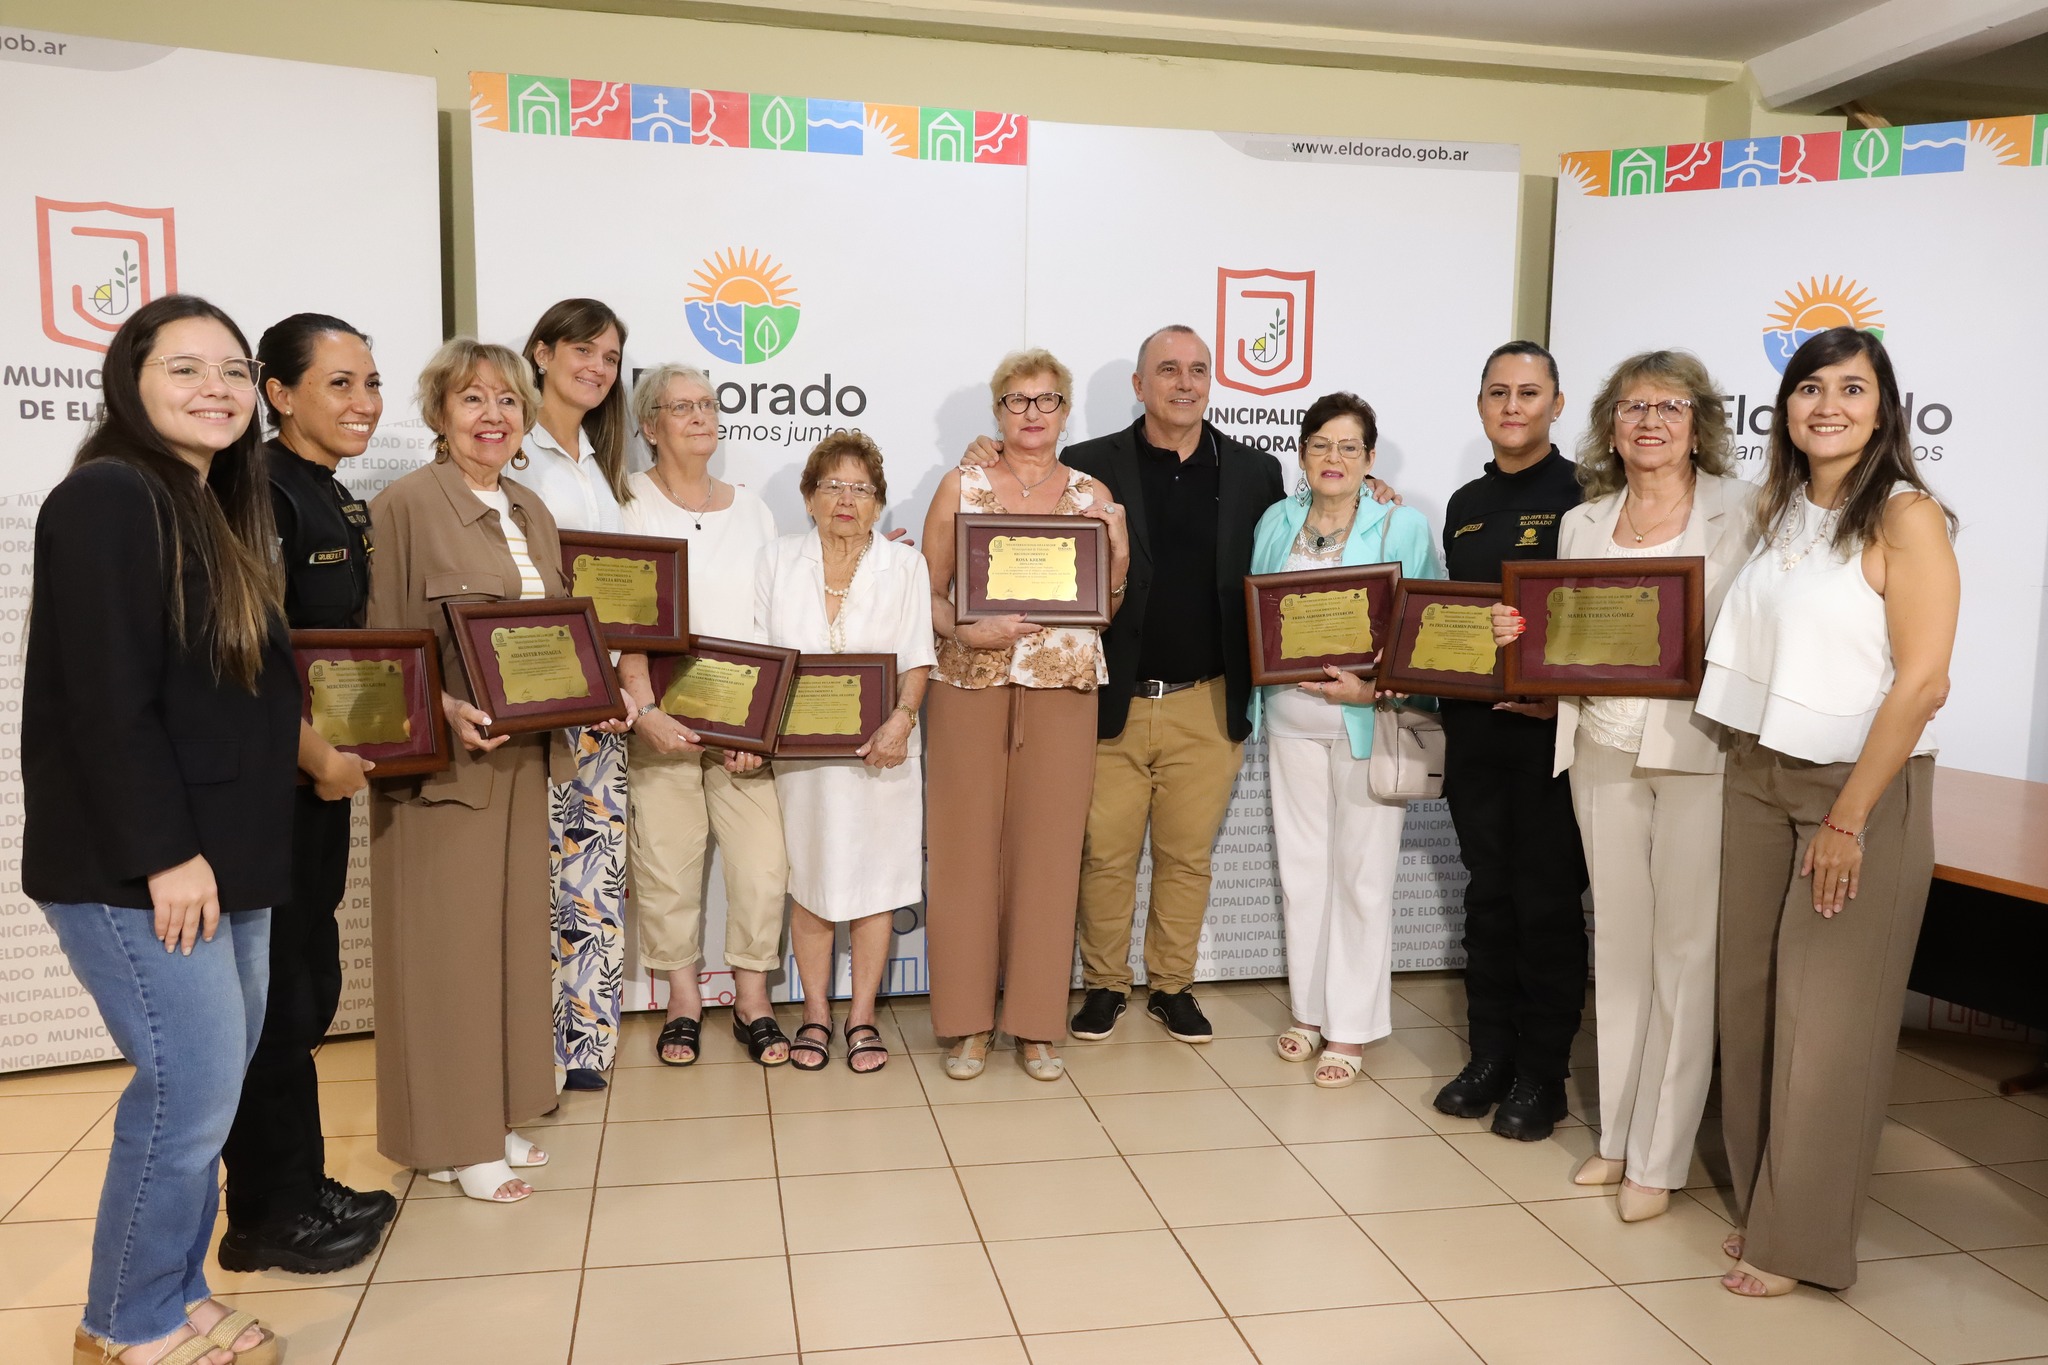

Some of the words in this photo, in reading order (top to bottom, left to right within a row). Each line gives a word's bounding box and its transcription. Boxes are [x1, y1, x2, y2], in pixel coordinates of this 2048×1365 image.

[0, 34, 67, 56] ob.ar
[1292, 141, 1469, 162] www.eldorado.gob.ar
[20, 399, 56, 420] DE
[1400, 907, 1415, 917] DE
[1397, 958, 1412, 969] DE
[1, 1006, 90, 1026] ELDORADO
